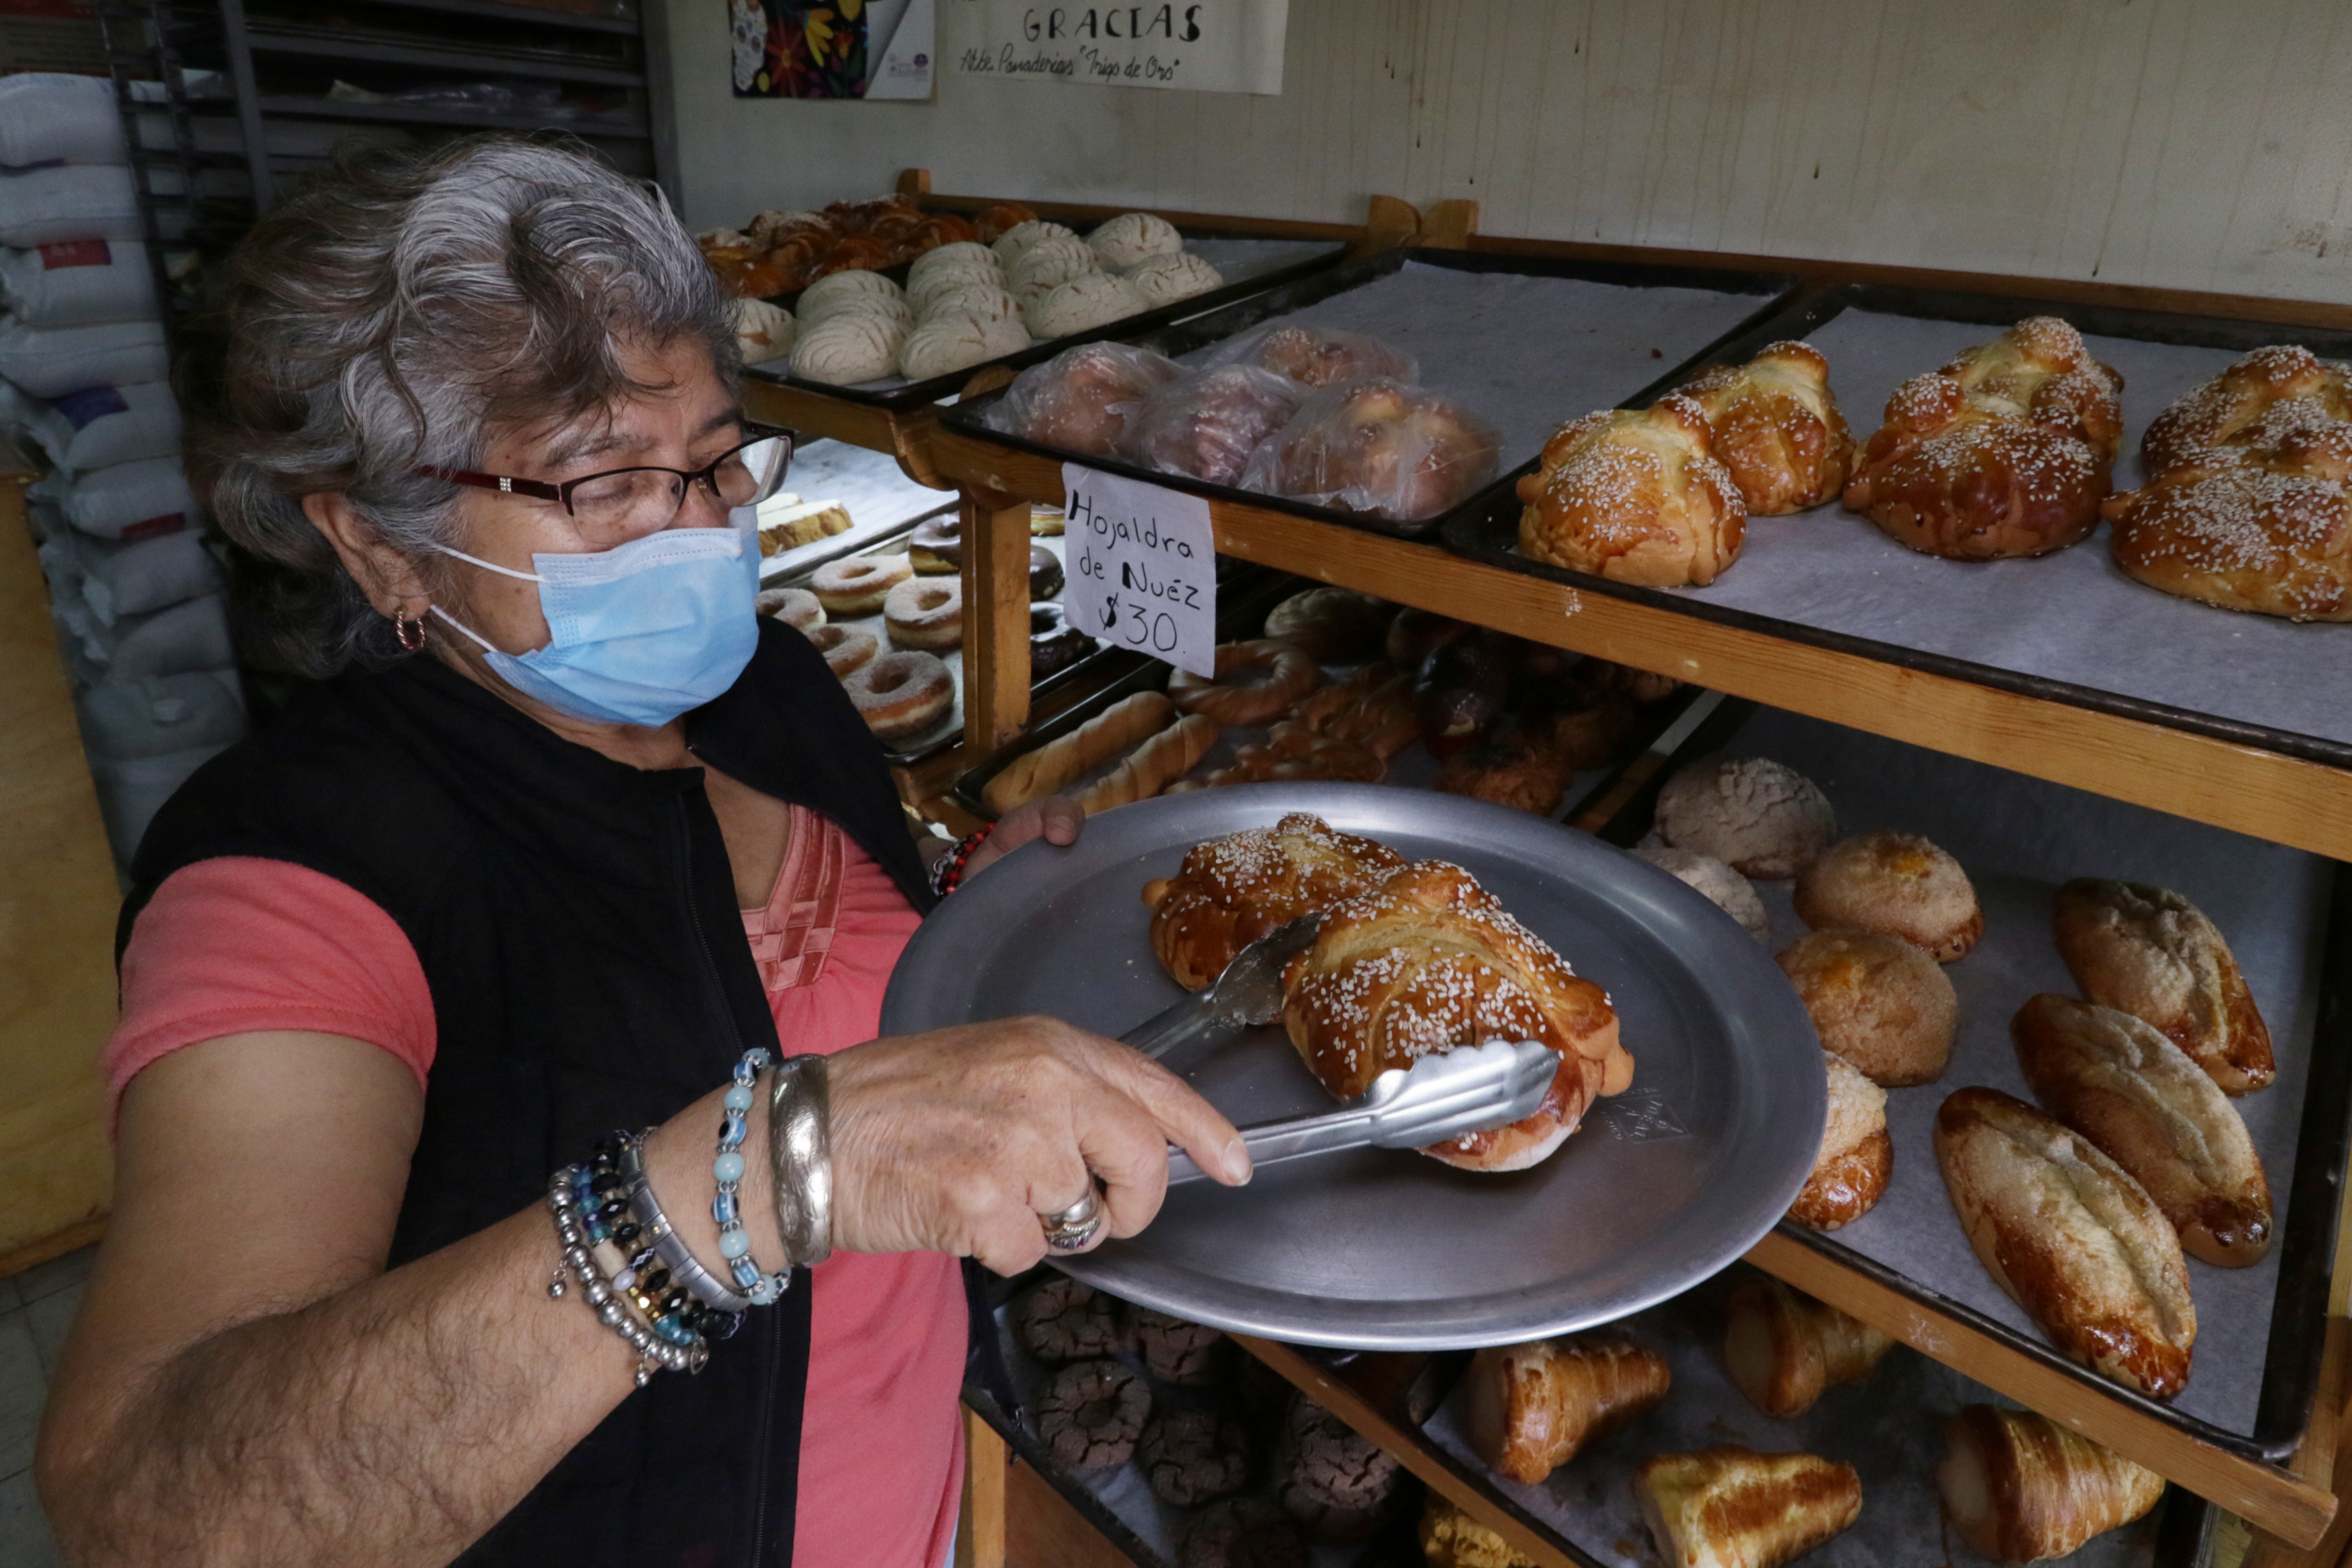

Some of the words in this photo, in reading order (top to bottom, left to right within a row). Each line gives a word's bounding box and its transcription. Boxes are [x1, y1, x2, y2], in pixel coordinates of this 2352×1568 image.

[1024, 4, 1201, 42] GRACIAS
[1124, 56, 1141, 77] de
[1069, 489, 1193, 558] Hojaldra
[1080, 546, 1105, 579] de
